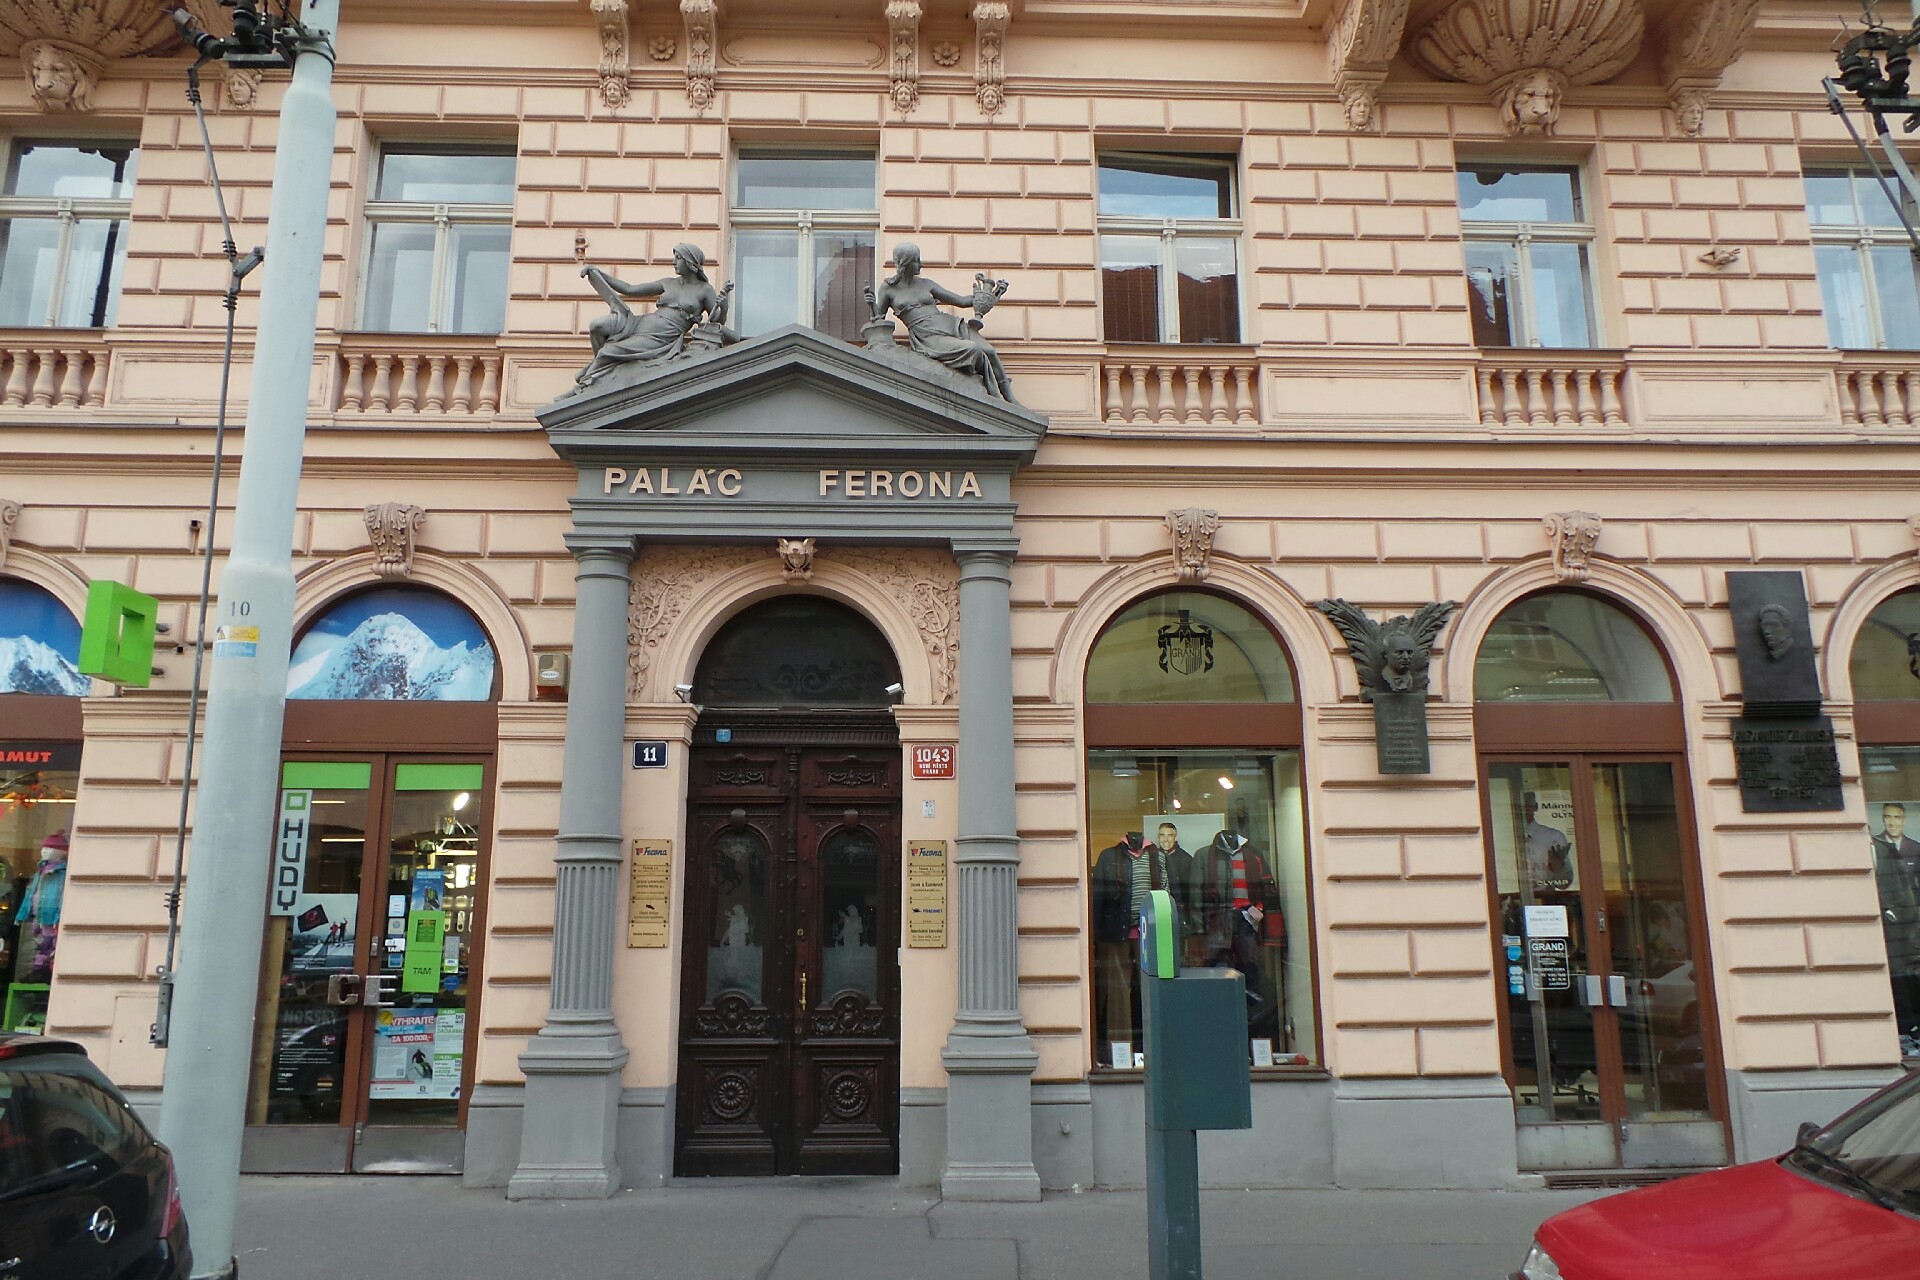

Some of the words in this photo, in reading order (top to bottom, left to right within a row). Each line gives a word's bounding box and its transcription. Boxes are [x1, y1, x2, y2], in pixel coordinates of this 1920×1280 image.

[604, 467, 743, 496] PALÁC
[819, 470, 983, 498] FERONA
[231, 601, 250, 616] 10
[1172, 648, 1201, 657] GRAND
[0, 751, 52, 763] MUT
[643, 746, 657, 762] 11
[916, 748, 950, 762] 1043
[644, 847, 668, 856] Ferona
[919, 848, 943, 857] Ferona
[276, 818, 304, 911] HUDY
[1531, 943, 1564, 951] GRAND
[413, 967, 432, 975] TAM
[391, 1016, 435, 1026] VYHRAJTE
